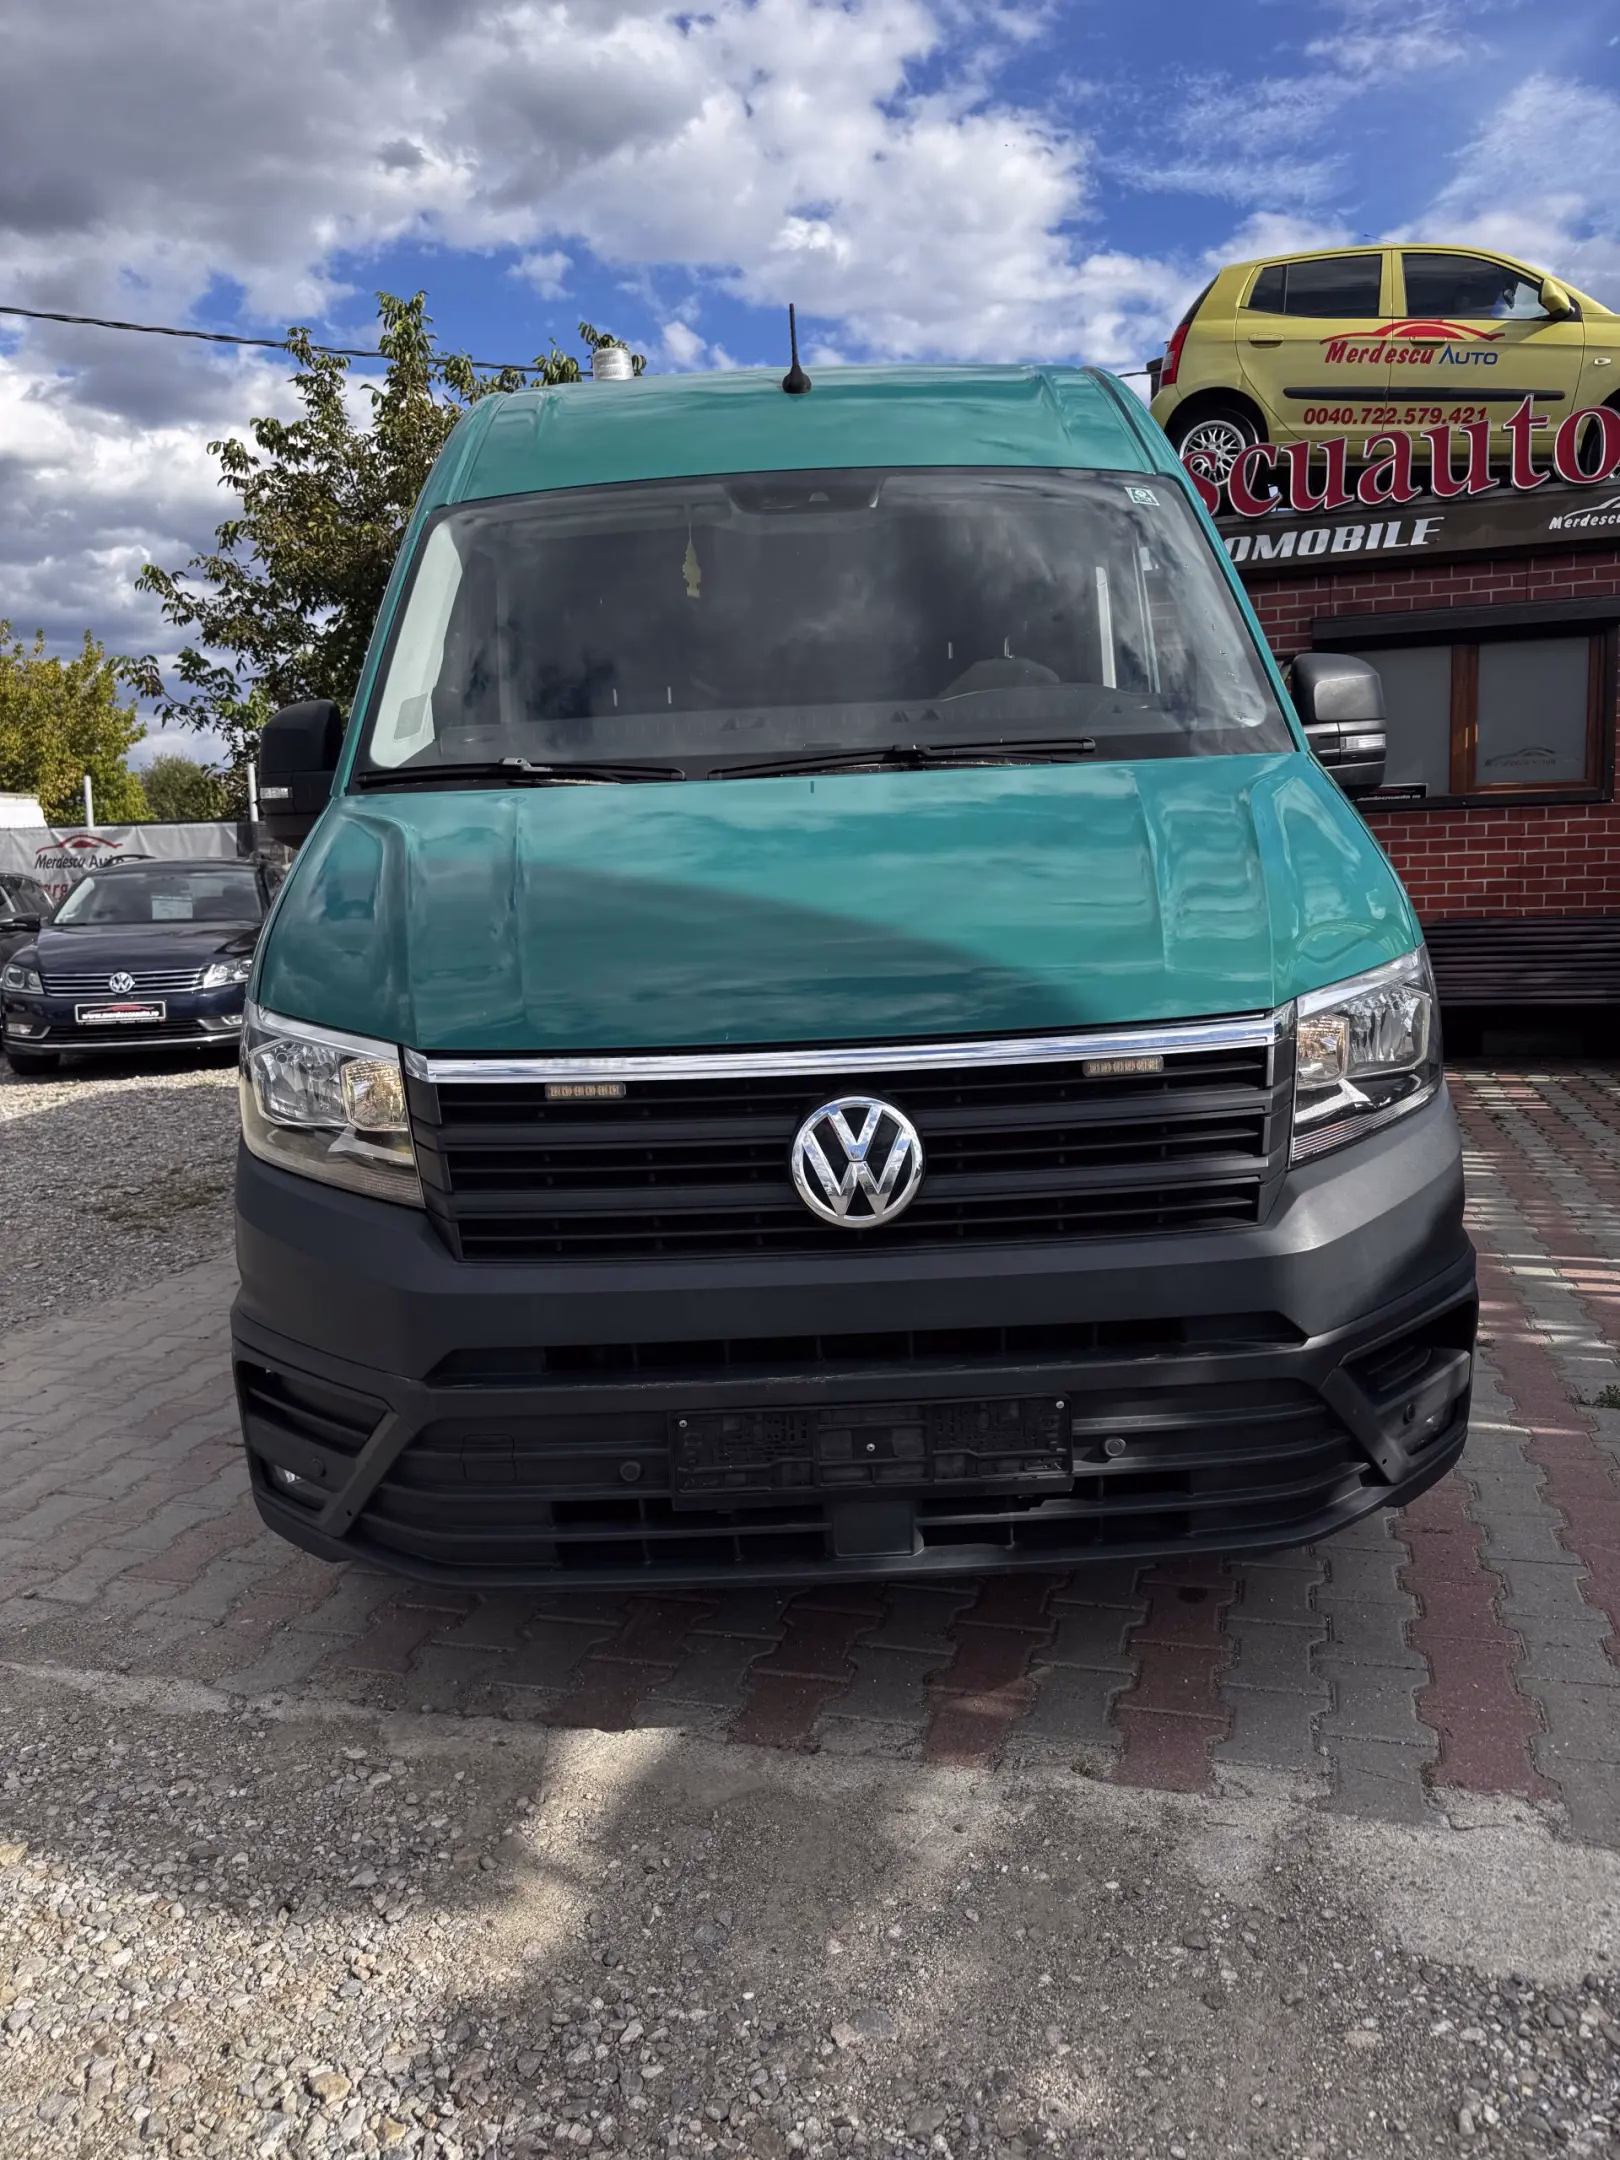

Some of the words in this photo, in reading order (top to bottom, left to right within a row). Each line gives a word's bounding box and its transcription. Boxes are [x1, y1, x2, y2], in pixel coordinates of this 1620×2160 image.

[1325, 340, 1435, 364] Merdescu
[1438, 345, 1498, 365] AUTO
[1303, 407, 1487, 425] 0040.722.579.421
